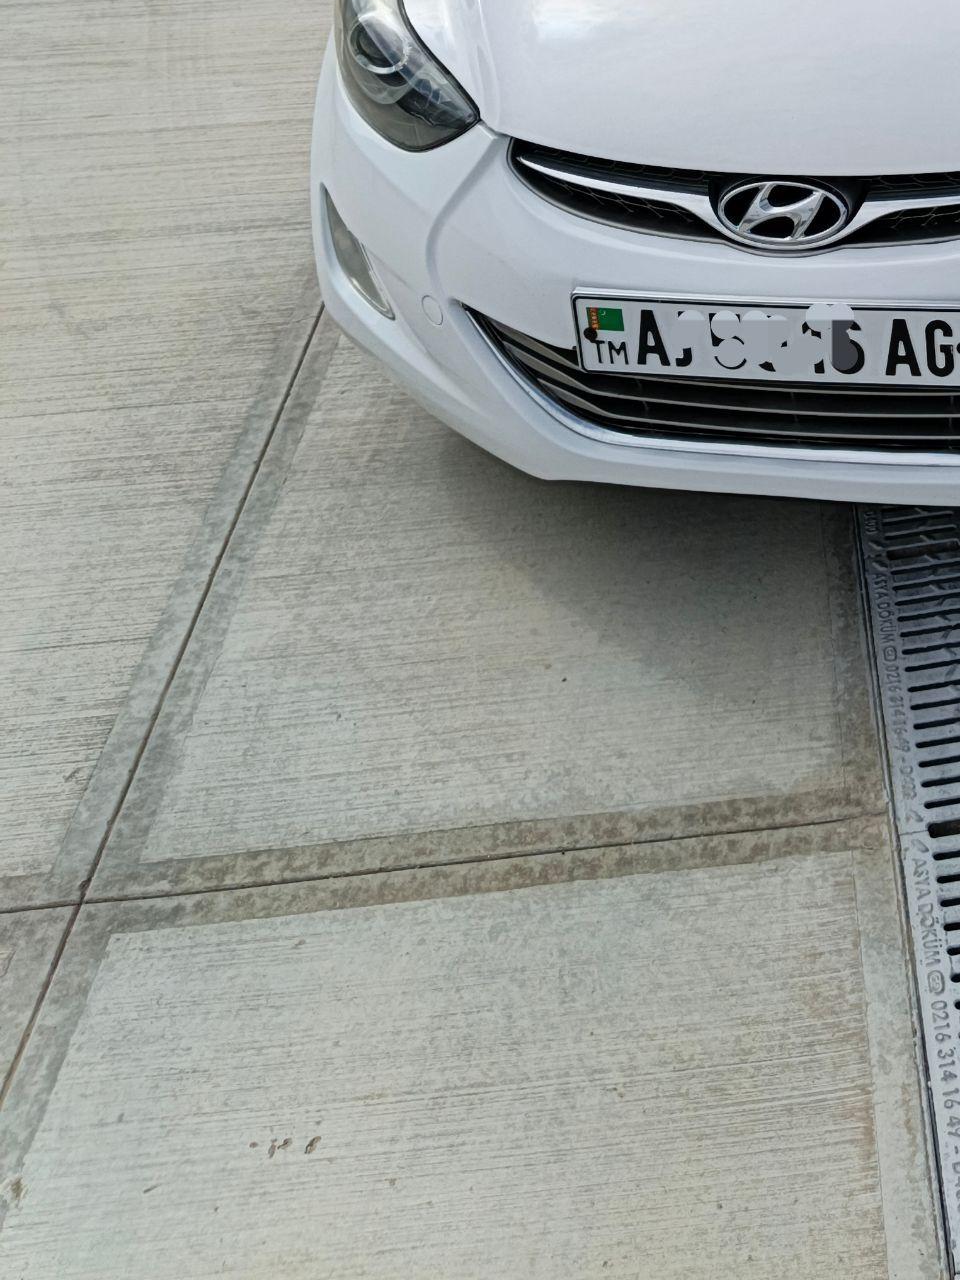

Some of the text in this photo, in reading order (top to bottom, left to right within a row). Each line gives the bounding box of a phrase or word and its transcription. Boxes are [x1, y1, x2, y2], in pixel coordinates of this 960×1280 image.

[595, 338, 630, 366] TM
[885, 317, 955, 378] AG
[911, 858, 931, 901] ASYA
[918, 902, 943, 968] DÖKÜM
[930, 999, 951, 1044] 0216
[937, 1047, 958, 1084] 314
[942, 1087, 960, 1110] 16
